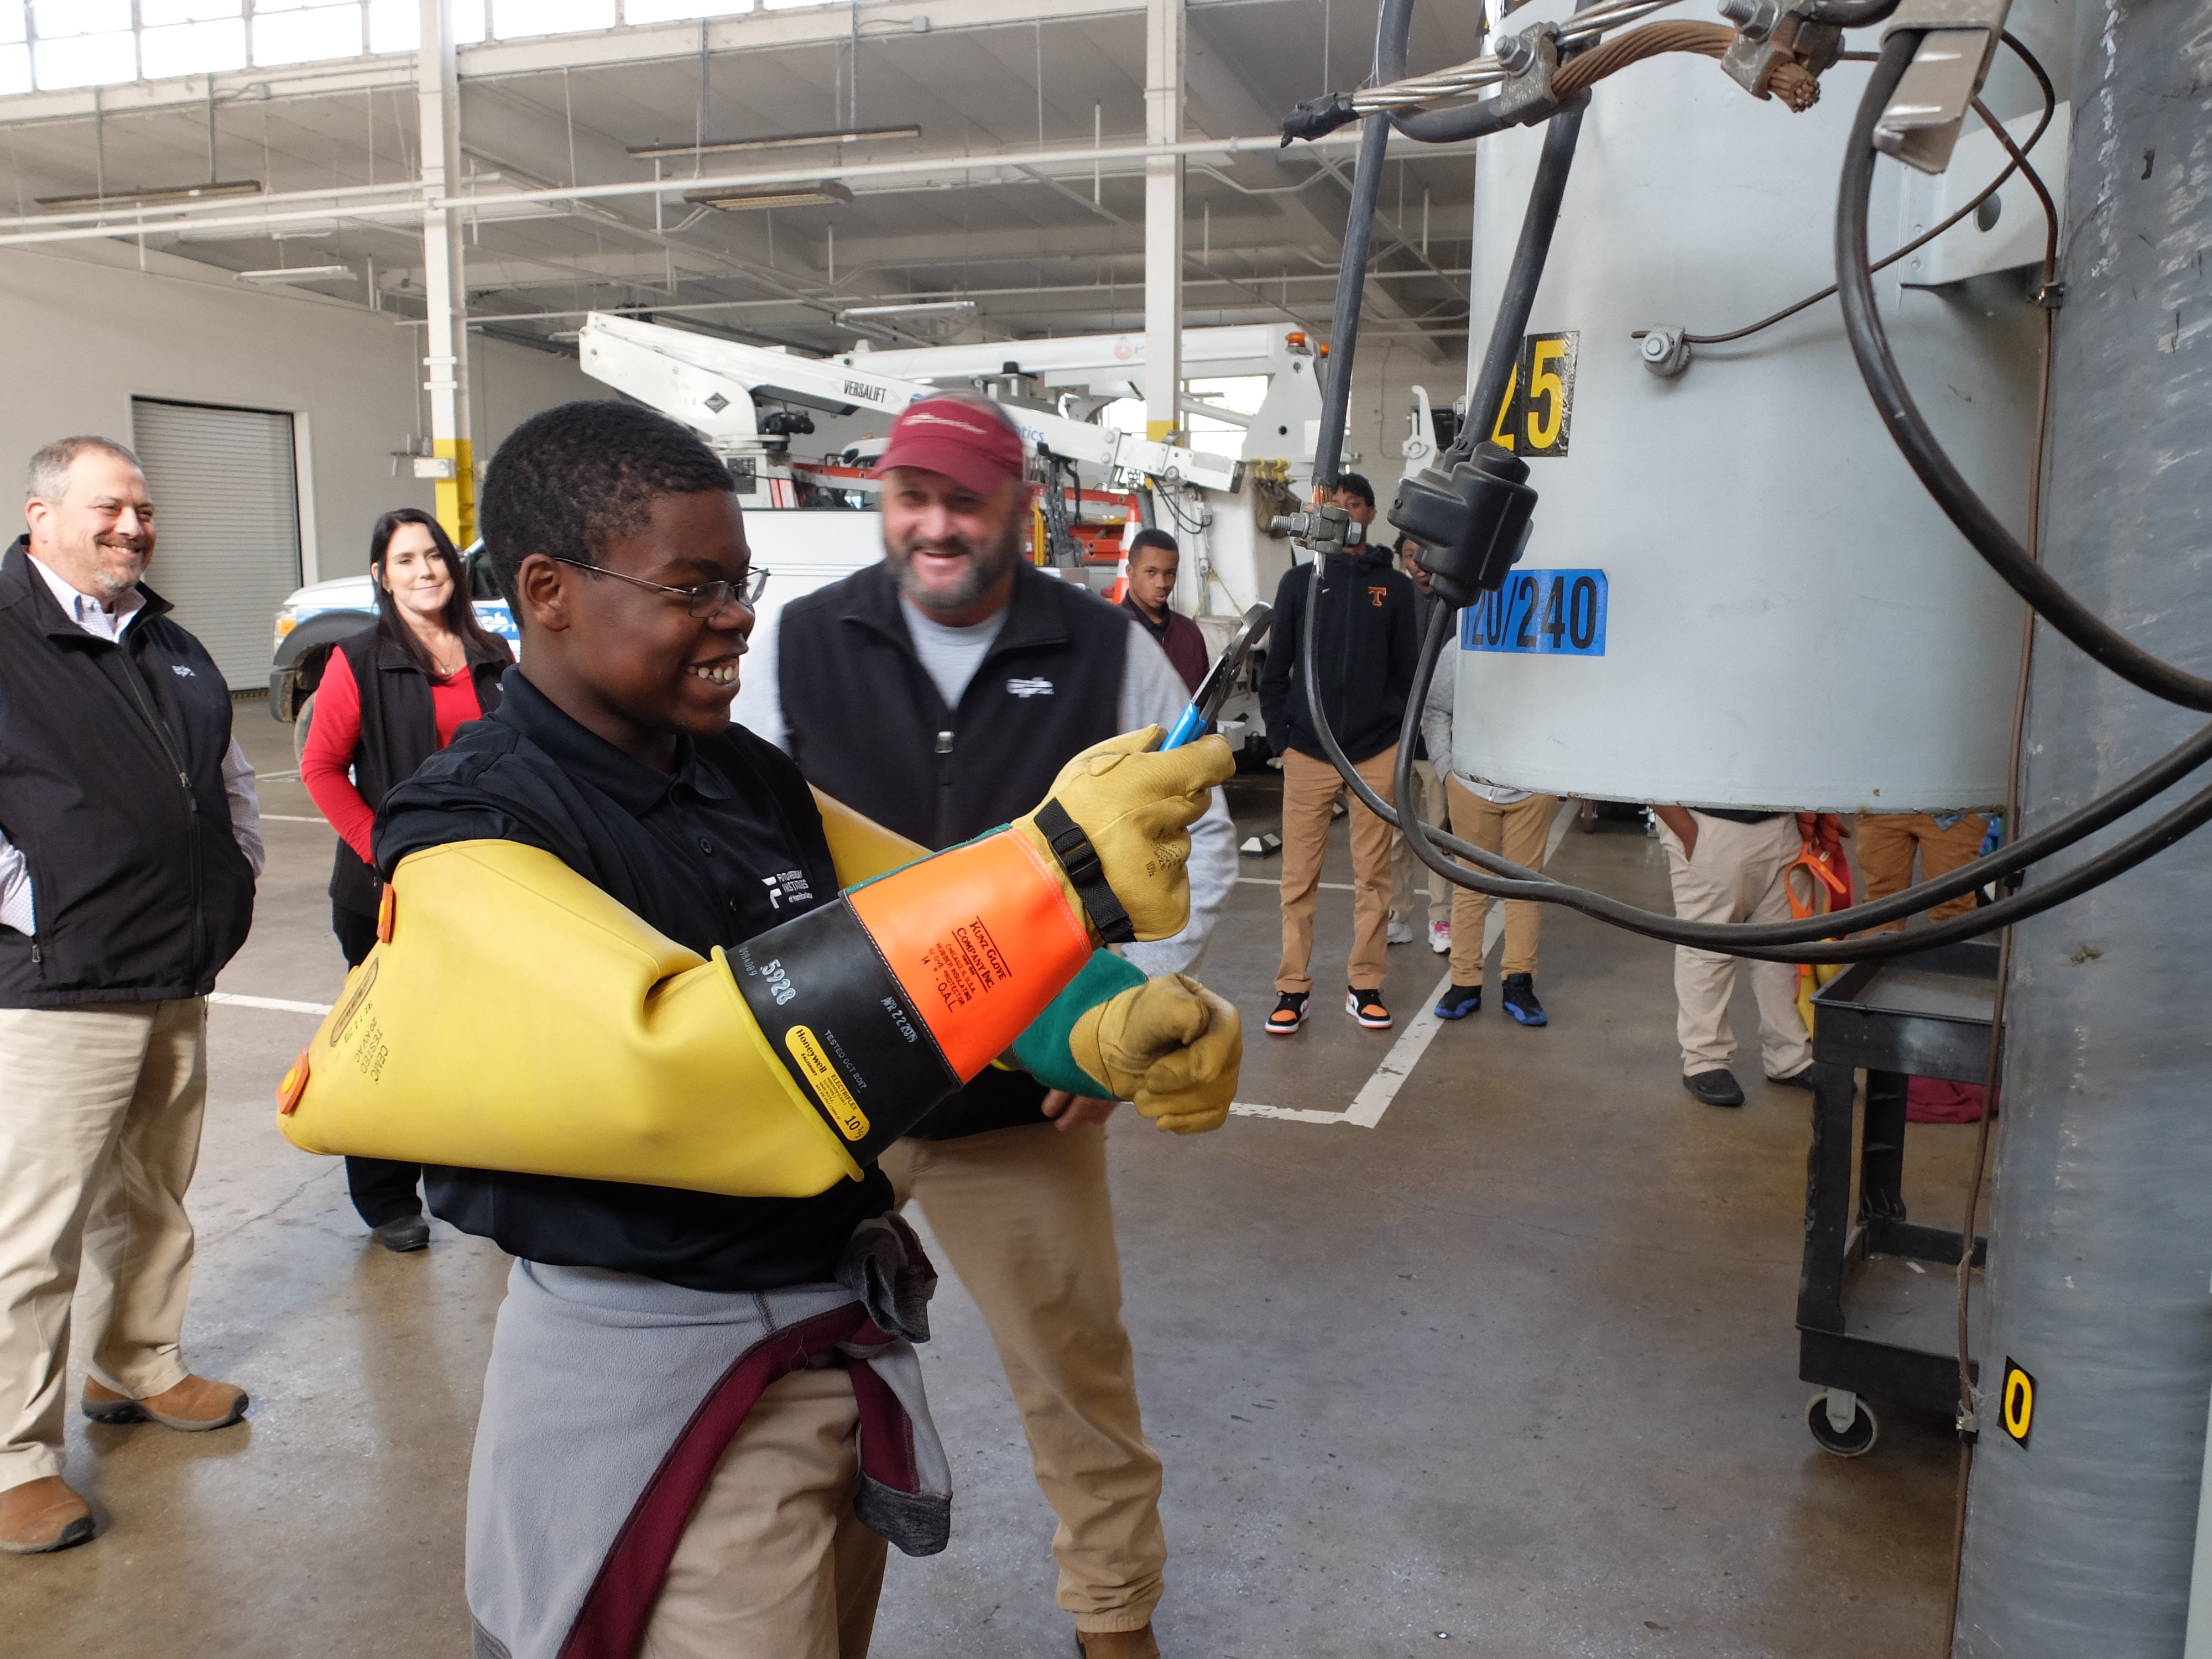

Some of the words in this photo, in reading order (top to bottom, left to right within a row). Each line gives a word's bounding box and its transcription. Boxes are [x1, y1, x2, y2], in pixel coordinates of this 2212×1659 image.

[843, 380, 887, 404] VERSALIFT
[1368, 586, 1387, 607] T
[1465, 576, 1598, 649] 120/240
[936, 942, 954, 968] RUBBER
[951, 968, 973, 1001] INSULATING
[957, 927, 987, 972] COMPANY
[969, 921, 989, 950] KUNZ
[987, 949, 1006, 980] GLOVE
[761, 959, 796, 1006] 5928
[929, 948, 945, 969] GLOVE
[943, 970, 966, 1006] PROTECTOR
[880, 996, 897, 1013] APR
[361, 1029, 383, 1074] TESTED
[371, 1045, 388, 1082] CEMC
[796, 1029, 828, 1074] Honeywell
[824, 1029, 846, 1058] TESTED
[843, 1058, 856, 1072] OCT
[831, 1073, 858, 1111] ELECTRIFLEX
